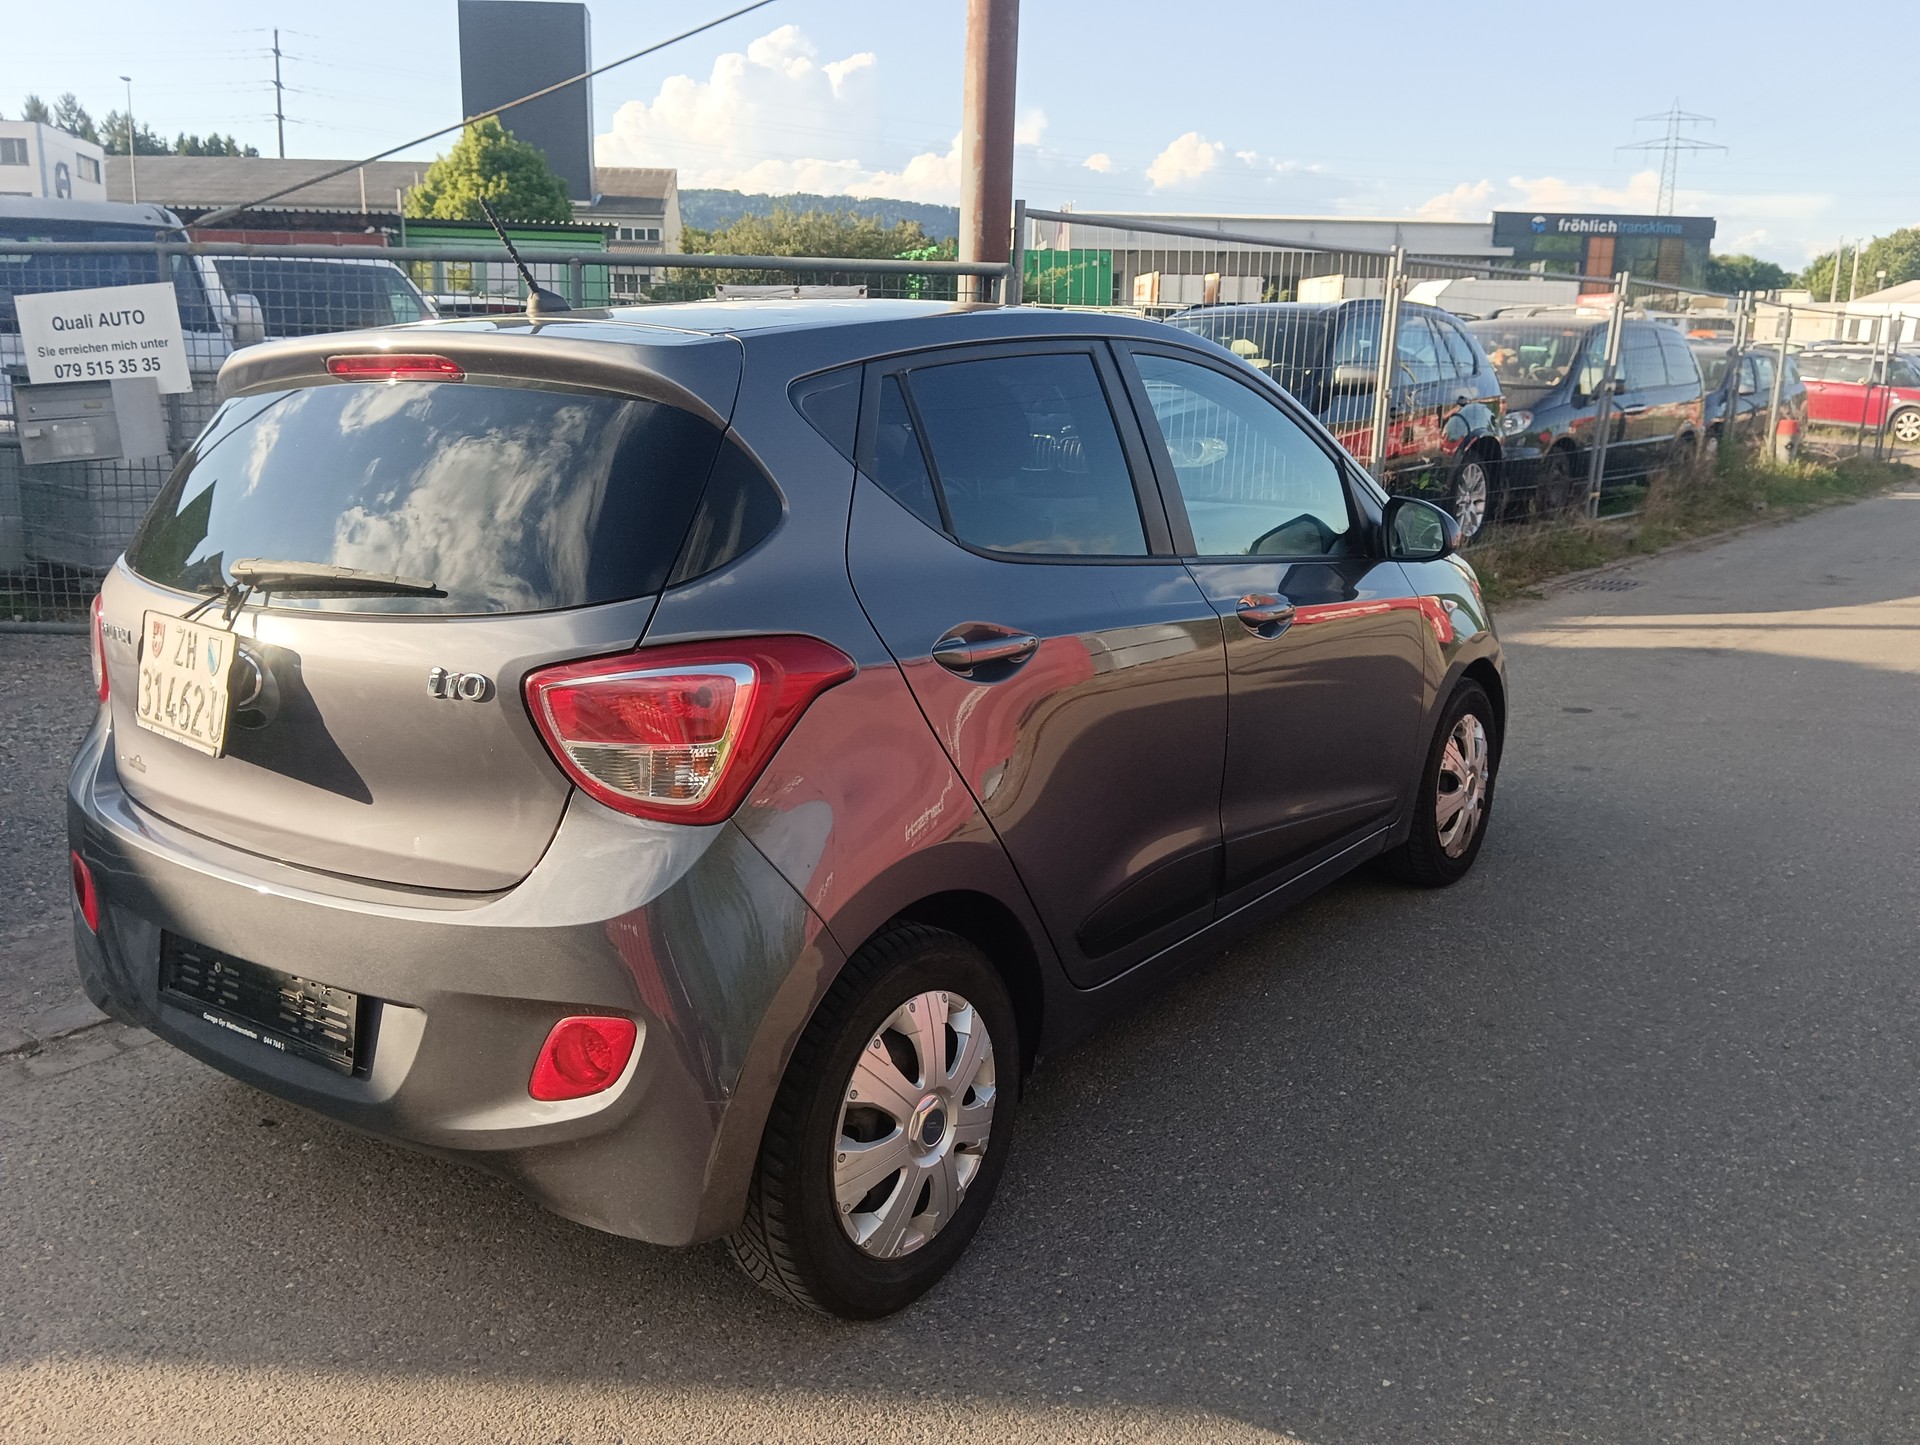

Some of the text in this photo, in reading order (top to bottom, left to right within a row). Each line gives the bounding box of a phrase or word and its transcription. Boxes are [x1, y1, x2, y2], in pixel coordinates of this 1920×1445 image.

[52, 310, 145, 331] Quali AUTO
[37, 338, 169, 358] Sie erreichen mich unter
[54, 356, 161, 379] 079 515 35 35
[174, 625, 198, 671] ZH
